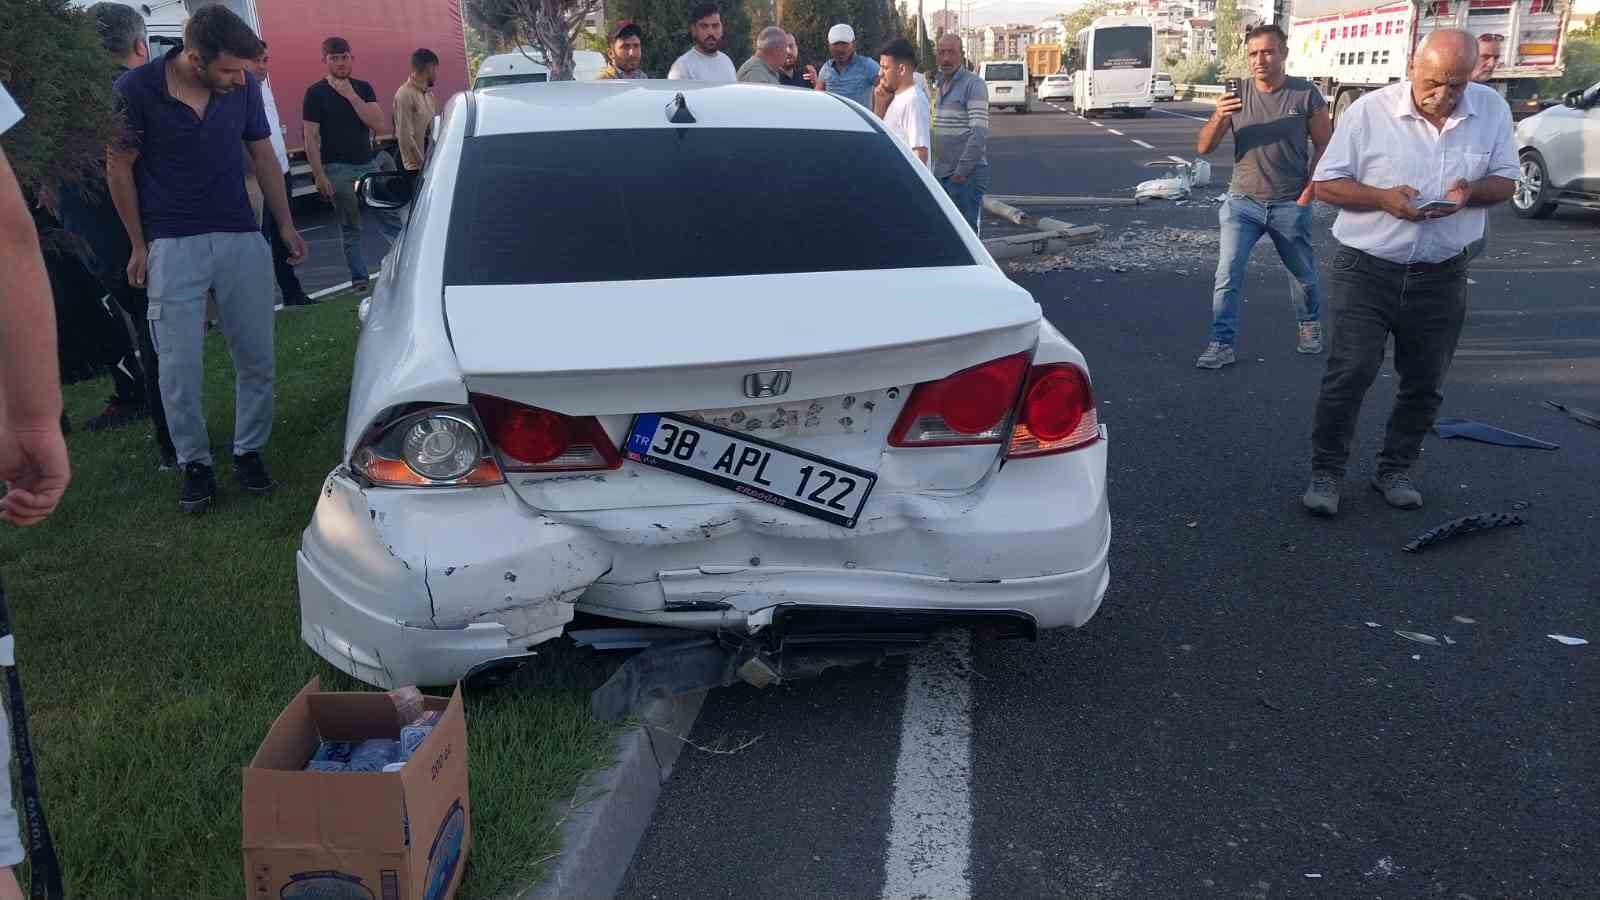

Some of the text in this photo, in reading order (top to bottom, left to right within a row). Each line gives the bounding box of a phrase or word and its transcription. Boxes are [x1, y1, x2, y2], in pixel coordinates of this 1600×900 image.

[634, 433, 650, 446] TR
[652, 423, 857, 511] 38 APL 122
[25, 796, 41, 851] VOLVO
